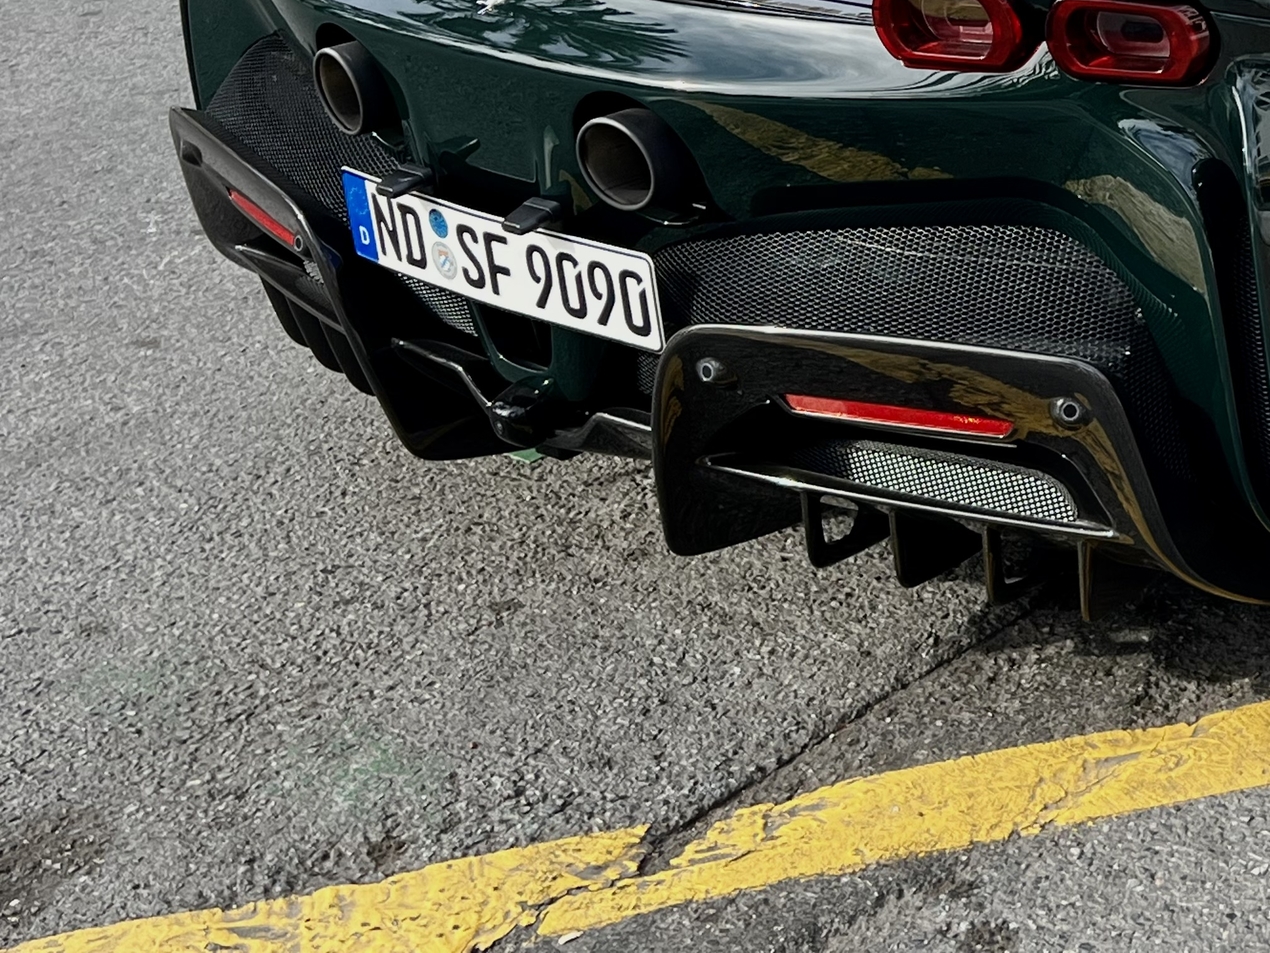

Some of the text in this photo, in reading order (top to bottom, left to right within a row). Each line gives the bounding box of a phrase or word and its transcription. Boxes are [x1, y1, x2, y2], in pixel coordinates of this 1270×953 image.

[358, 225, 370, 245] D
[371, 191, 651, 337] ND SF 9090
